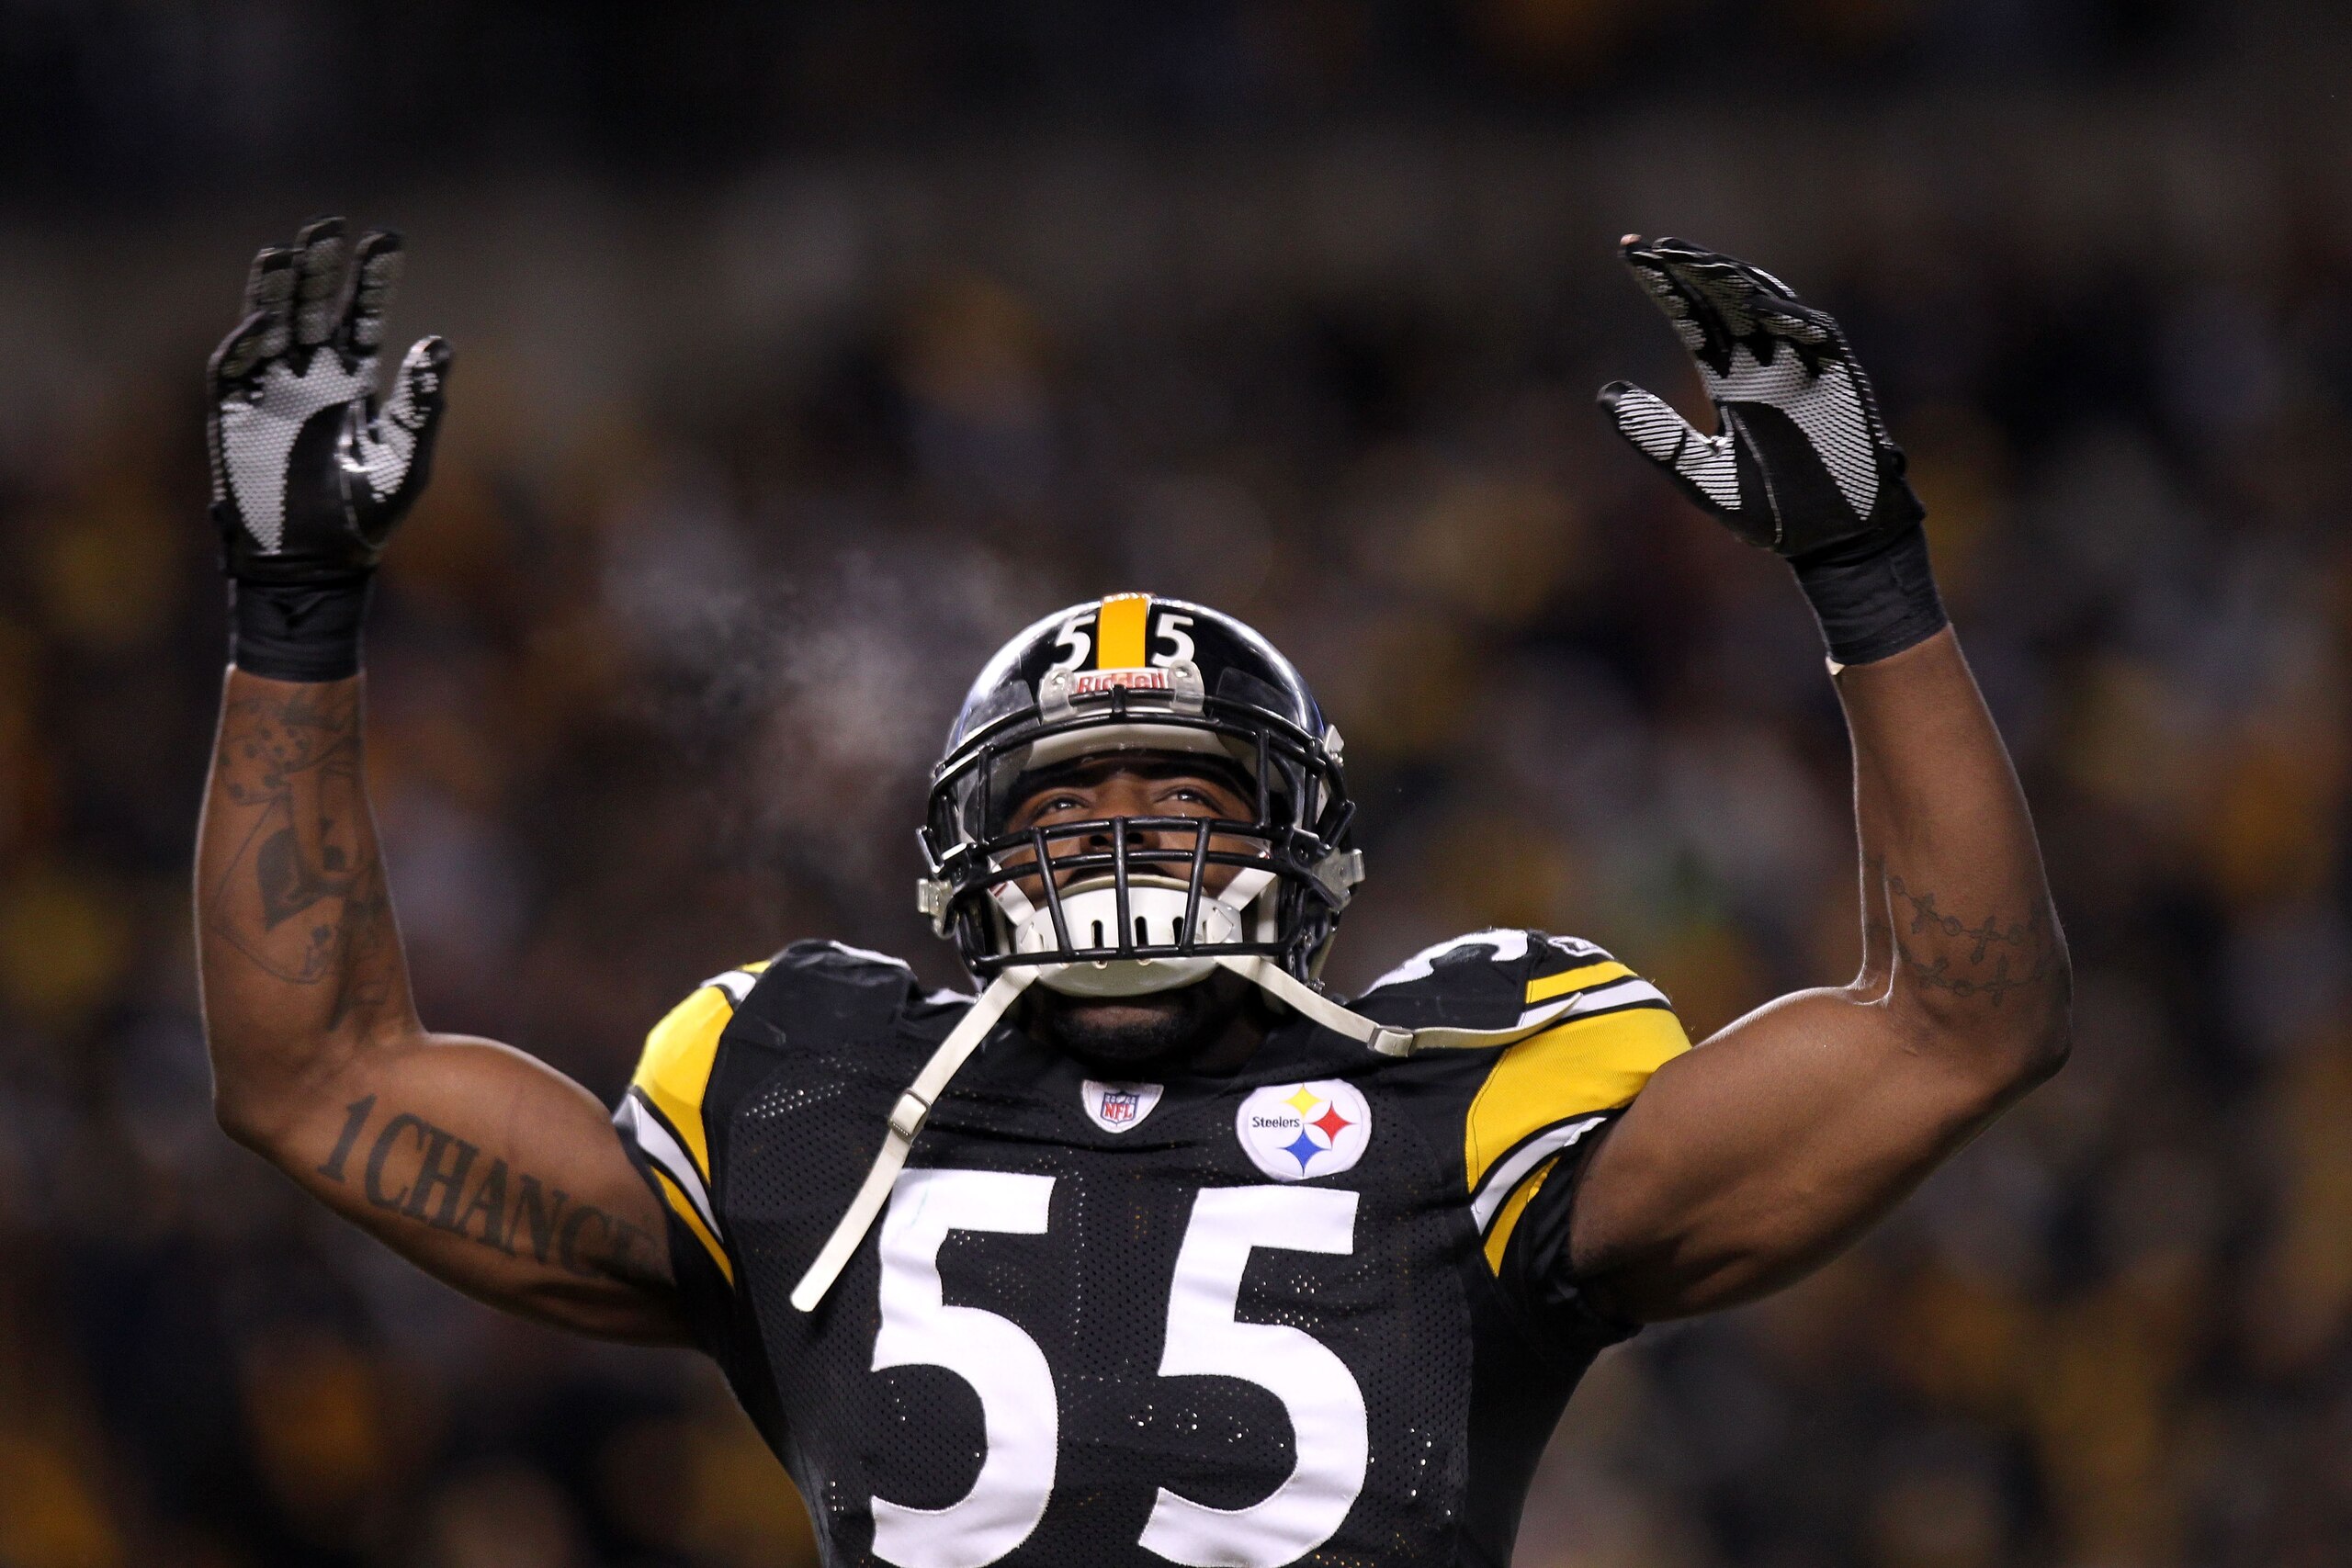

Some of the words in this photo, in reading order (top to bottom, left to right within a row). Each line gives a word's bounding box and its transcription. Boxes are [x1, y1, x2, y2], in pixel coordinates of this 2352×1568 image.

[1078, 671, 1166, 694] Riddell
[1104, 1102, 1133, 1120] NFL
[1251, 1115, 1301, 1129] Steelers
[317, 1093, 378, 1183] 1
